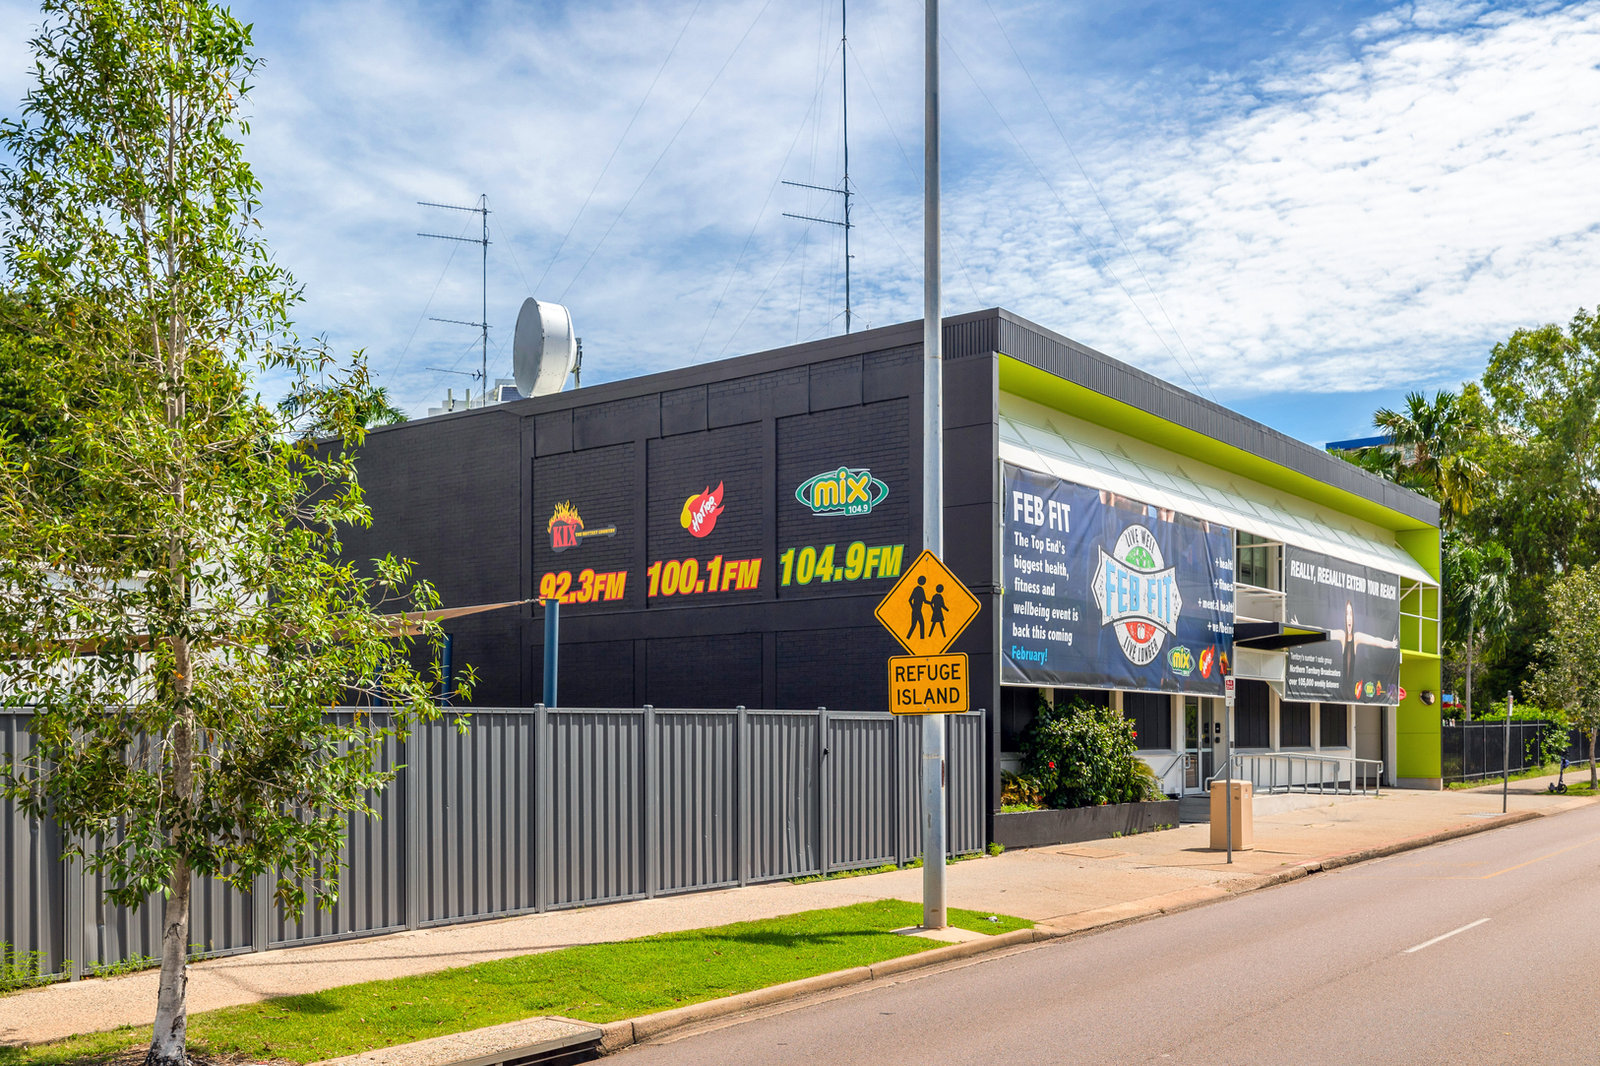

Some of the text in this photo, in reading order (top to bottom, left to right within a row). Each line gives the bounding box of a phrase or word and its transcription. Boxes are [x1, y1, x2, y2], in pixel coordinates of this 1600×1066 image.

[814, 470, 869, 507] mix
[848, 504, 868, 514] 104.9
[1012, 490, 1070, 532] FEB FIT
[552, 524, 578, 548] KIX
[1014, 531, 1066, 554] The Top End's
[1124, 528, 1155, 554] LIVE WELL
[779, 540, 904, 586] 104.9FM
[1014, 554, 1070, 580] biggest health,
[539, 568, 628, 606] 92.3FM
[647, 555, 762, 597] 100.1FM
[1014, 576, 1056, 596] fitness and
[1219, 578, 1234, 592] fitnes
[1290, 560, 1316, 584] REALLY,
[1346, 574, 1366, 593] EXTEND
[1367, 579, 1380, 596] YOUR
[1380, 583, 1396, 600] REACH
[1106, 560, 1172, 624] FEB FIT
[1013, 600, 1078, 622] wellbeing event is
[1202, 599, 1219, 611] mental
[1012, 622, 1073, 646] back this coming
[1011, 645, 1048, 666] February!
[1124, 636, 1136, 661] LIVE
[1172, 648, 1190, 669] mix
[895, 664, 960, 682] REFUGE
[897, 687, 960, 706] ISLAND
